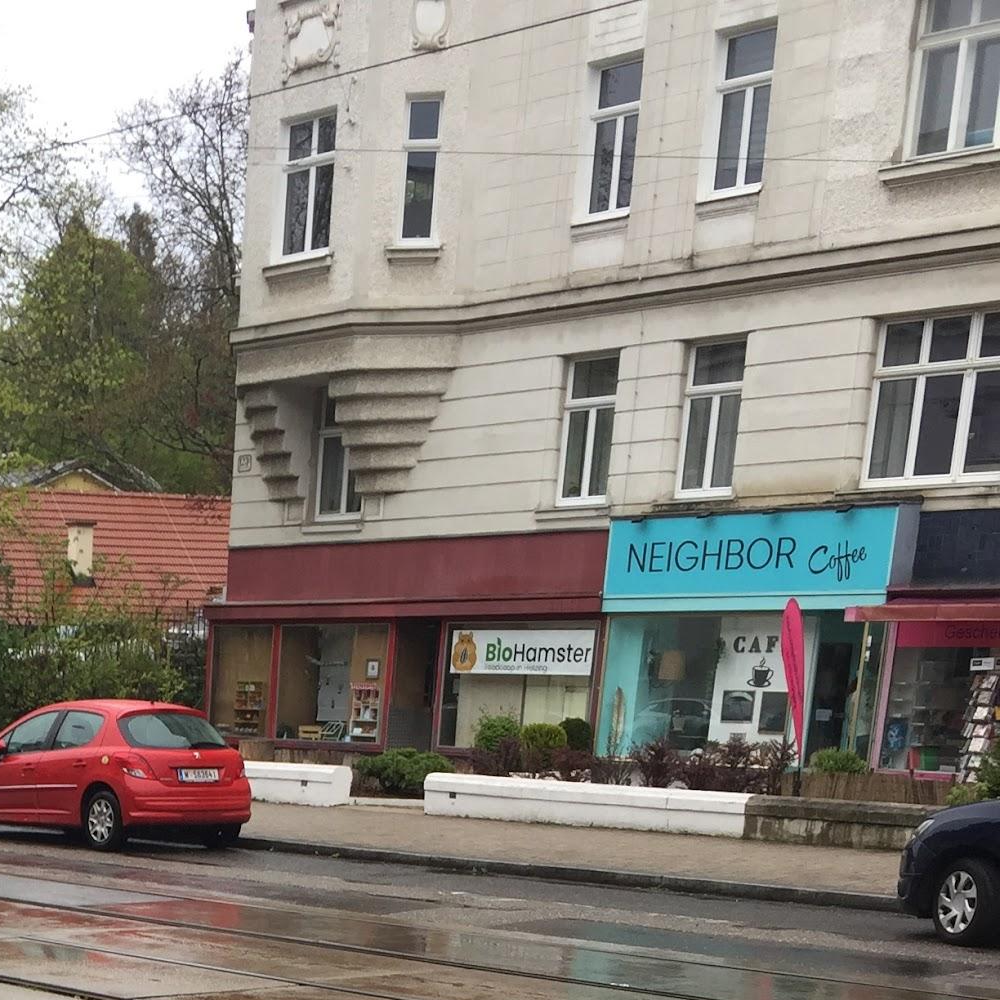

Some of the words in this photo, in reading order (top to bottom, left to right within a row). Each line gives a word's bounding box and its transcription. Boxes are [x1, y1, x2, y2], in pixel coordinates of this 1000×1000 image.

[626, 536, 797, 573] NEIGHBOR
[808, 540, 867, 582] Coffee
[485, 638, 592, 663] BioHamster
[733, 635, 779, 653] CAF
